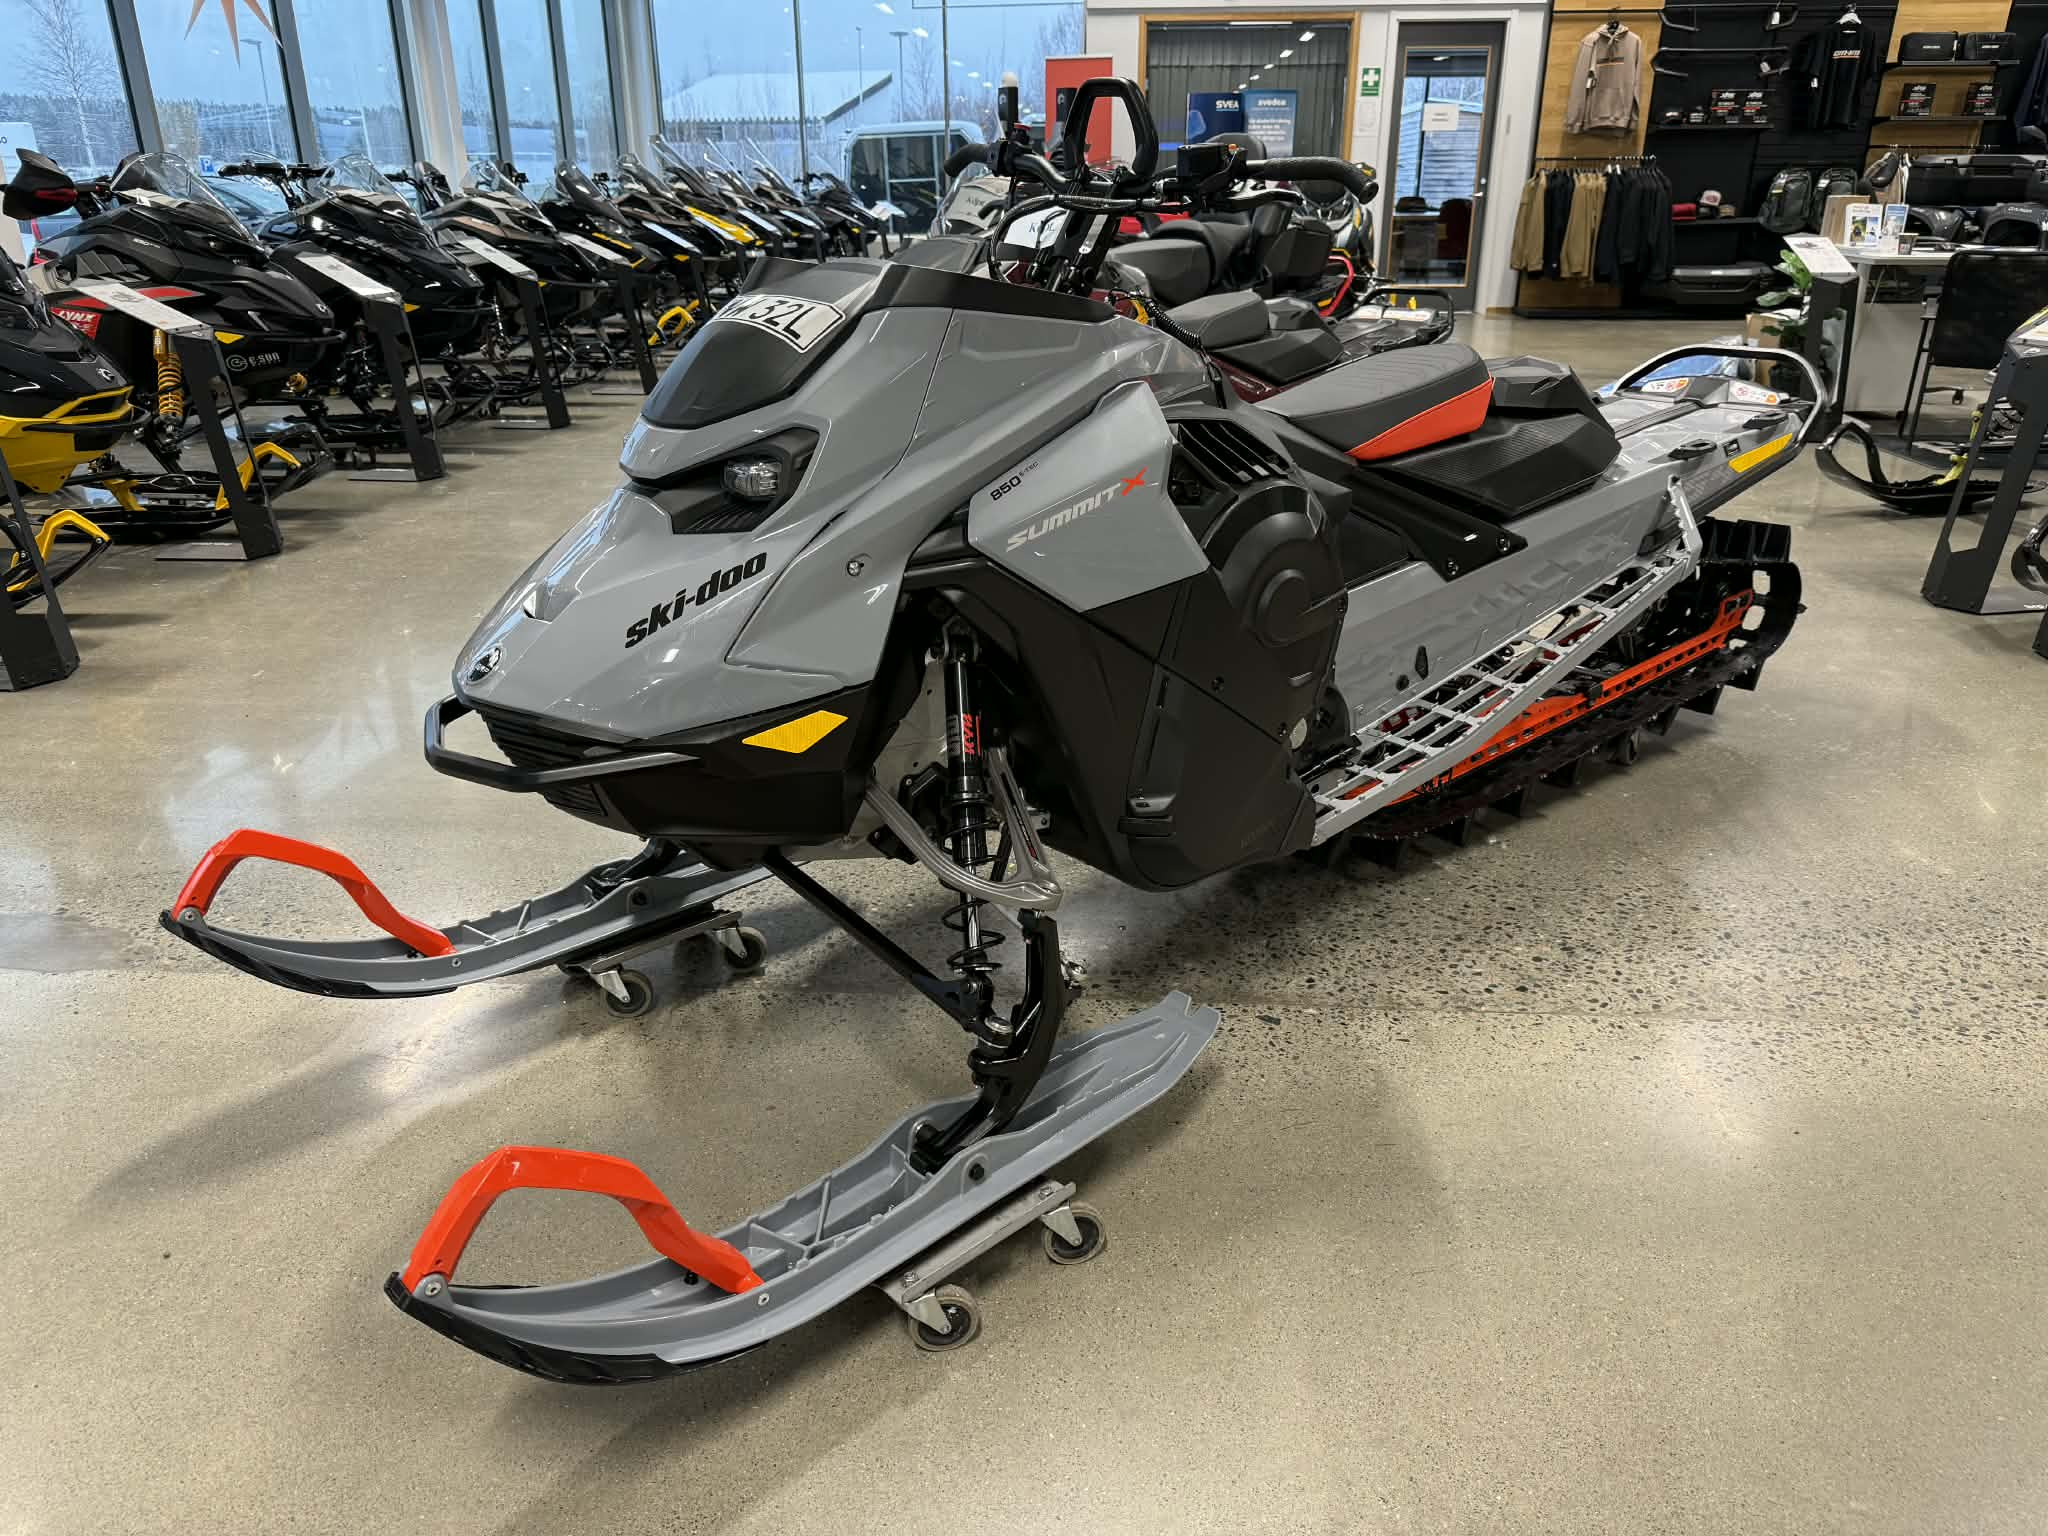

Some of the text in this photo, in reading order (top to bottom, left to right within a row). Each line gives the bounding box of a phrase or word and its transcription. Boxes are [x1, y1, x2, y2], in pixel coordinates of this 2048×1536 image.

[1216, 100, 1239, 109] SVEA
[58, 310, 97, 323] LYNX
[749, 300, 816, 340] 32L
[990, 475, 1021, 501] 850
[1120, 466, 1148, 497] X
[624, 552, 768, 649] ski-doo
